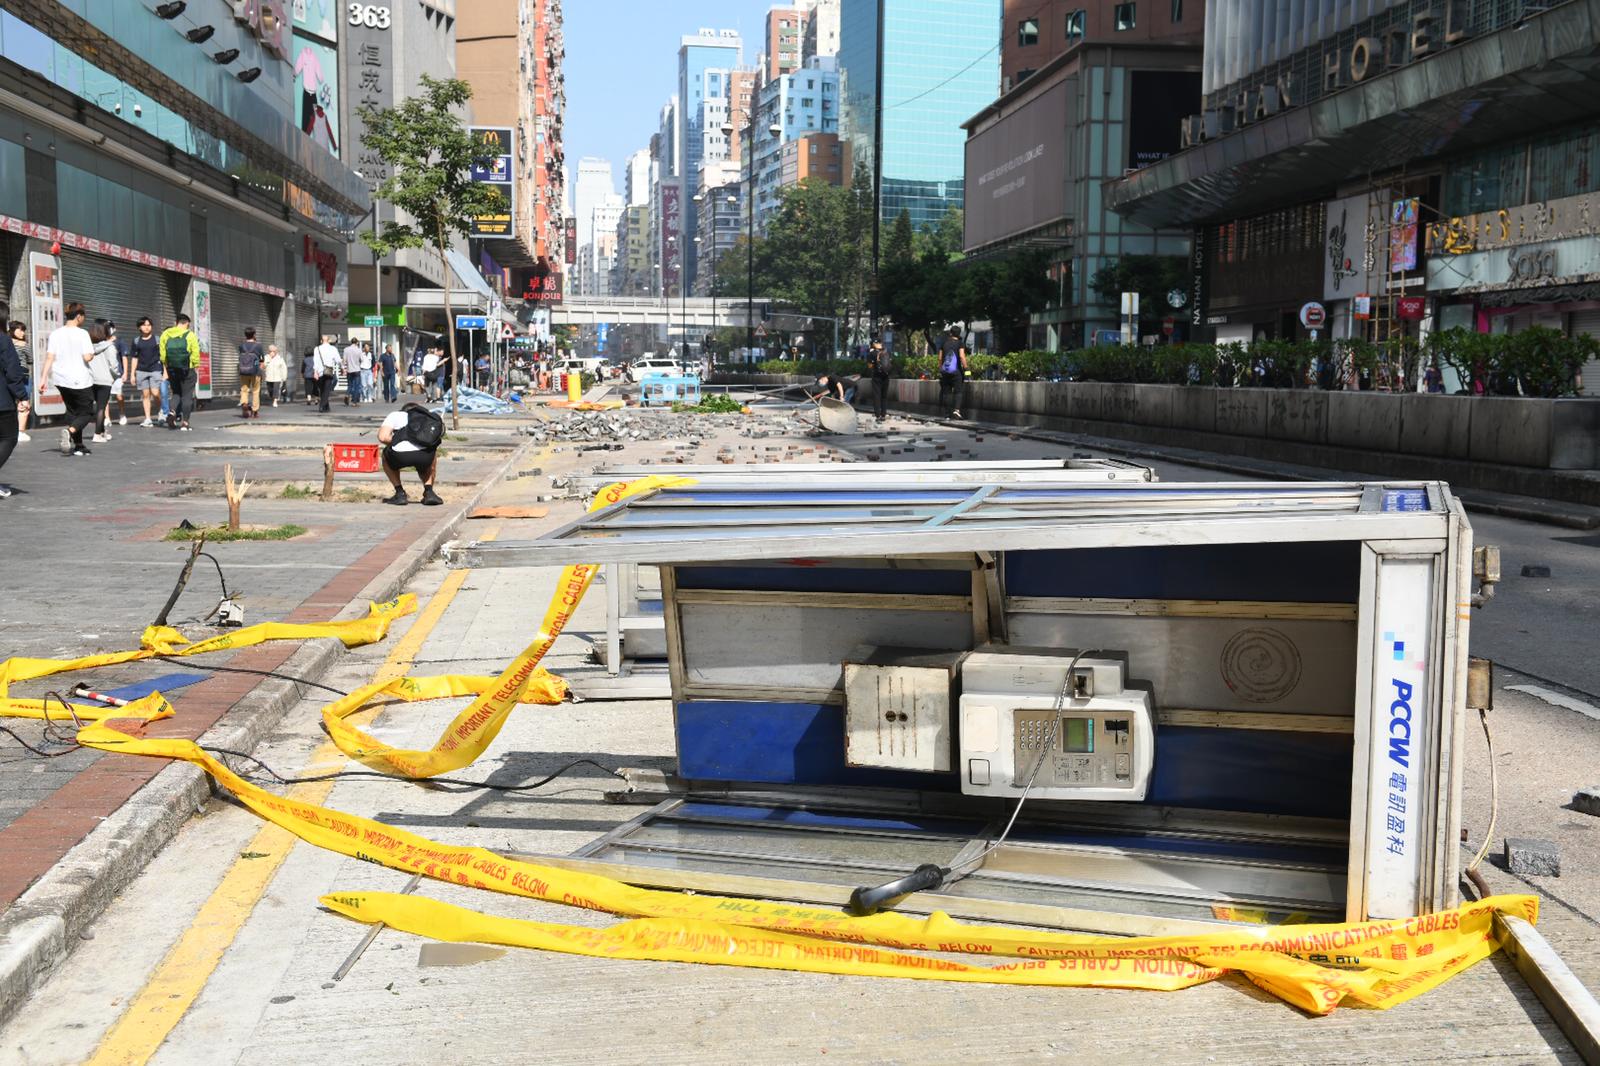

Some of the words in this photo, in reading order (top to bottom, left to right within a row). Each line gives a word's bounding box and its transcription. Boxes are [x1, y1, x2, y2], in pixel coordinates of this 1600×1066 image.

[348, 2, 391, 30] 363
[1181, 71, 1304, 149] NATHAN
[1324, 0, 1474, 91] HOTEL
[358, 153, 386, 167] HANG
[1194, 227, 1204, 269] HOTEL
[523, 292, 561, 300] BONJOUR
[1192, 275, 1202, 326] NATHAN
[455, 702, 497, 741] IMPORTANT
[492, 611, 569, 704] TELECOMMUNICATION
[562, 564, 591, 606] CABLES
[1387, 677, 1413, 768] PCCW
[1386, 771, 1408, 857] 電訊盈科
[473, 859, 511, 881] CABLES
[511, 872, 550, 896] BELOW
[1405, 912, 1460, 937] CABLES
